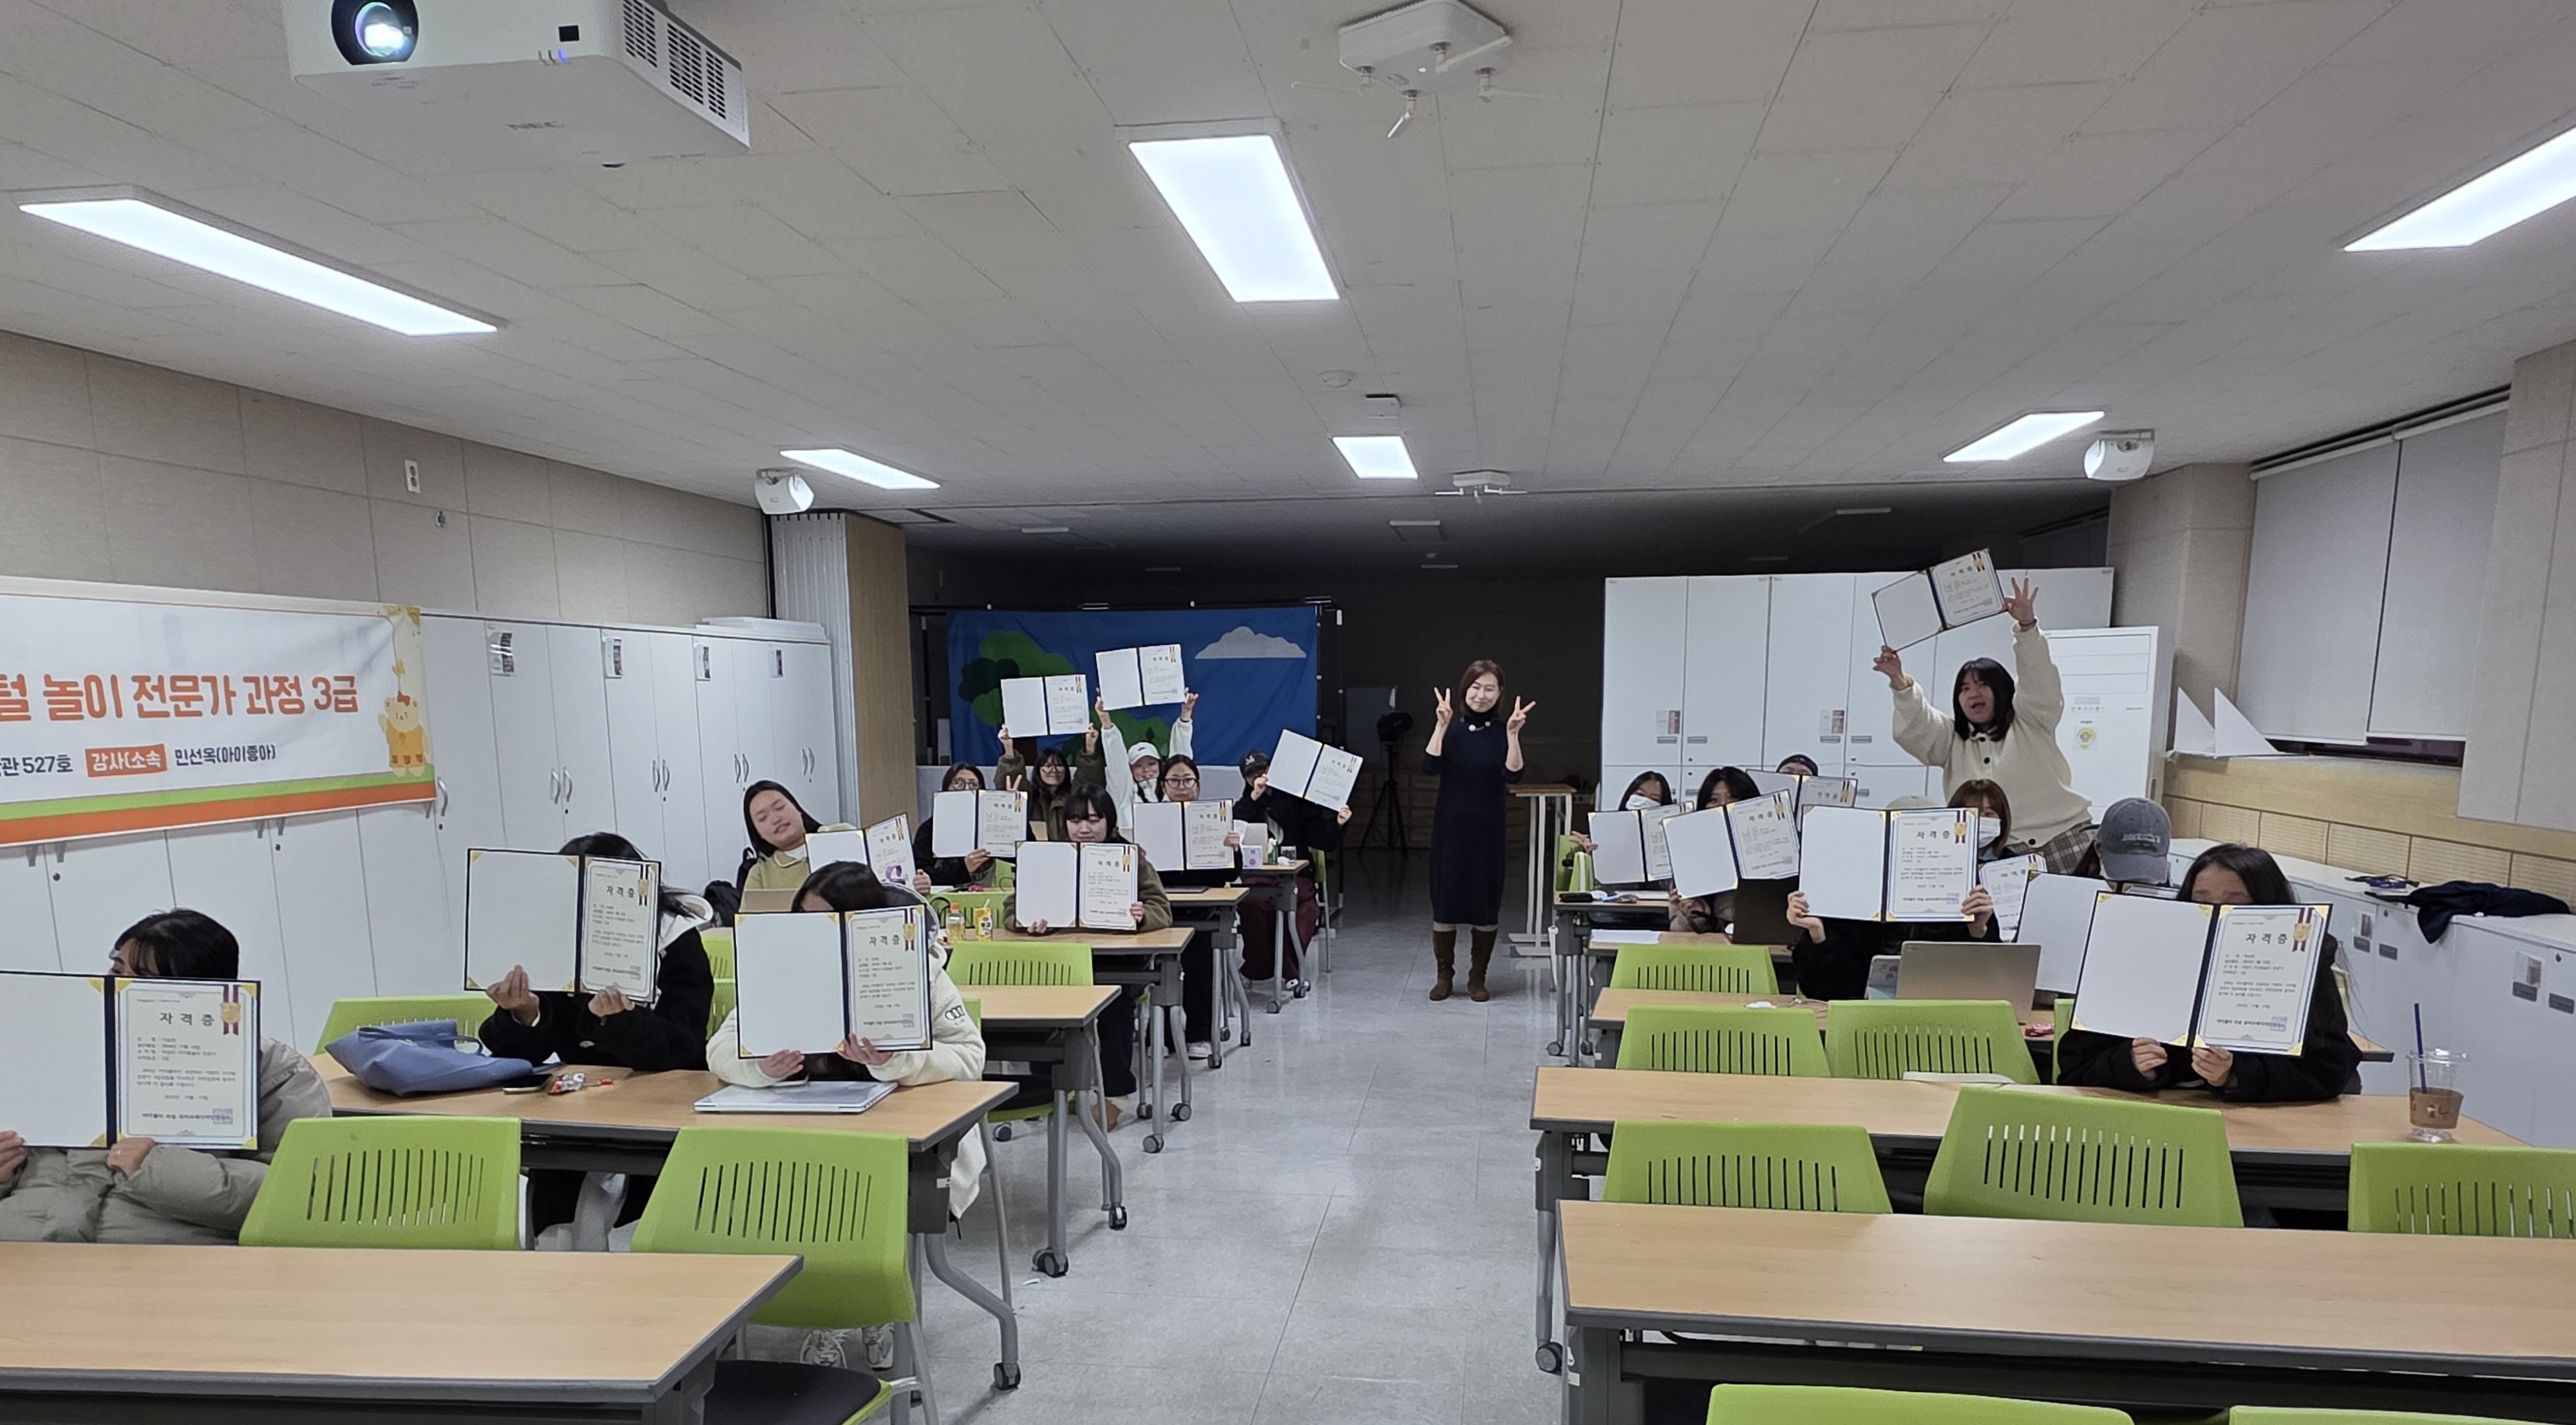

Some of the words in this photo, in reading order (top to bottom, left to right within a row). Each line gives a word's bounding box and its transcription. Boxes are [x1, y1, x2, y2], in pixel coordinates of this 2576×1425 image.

[43, 674, 123, 721] 놀이
[131, 675, 236, 718] 전문가
[243, 675, 305, 715] 과정
[312, 675, 358, 713] 3급
[22, 754, 73, 773] 527호
